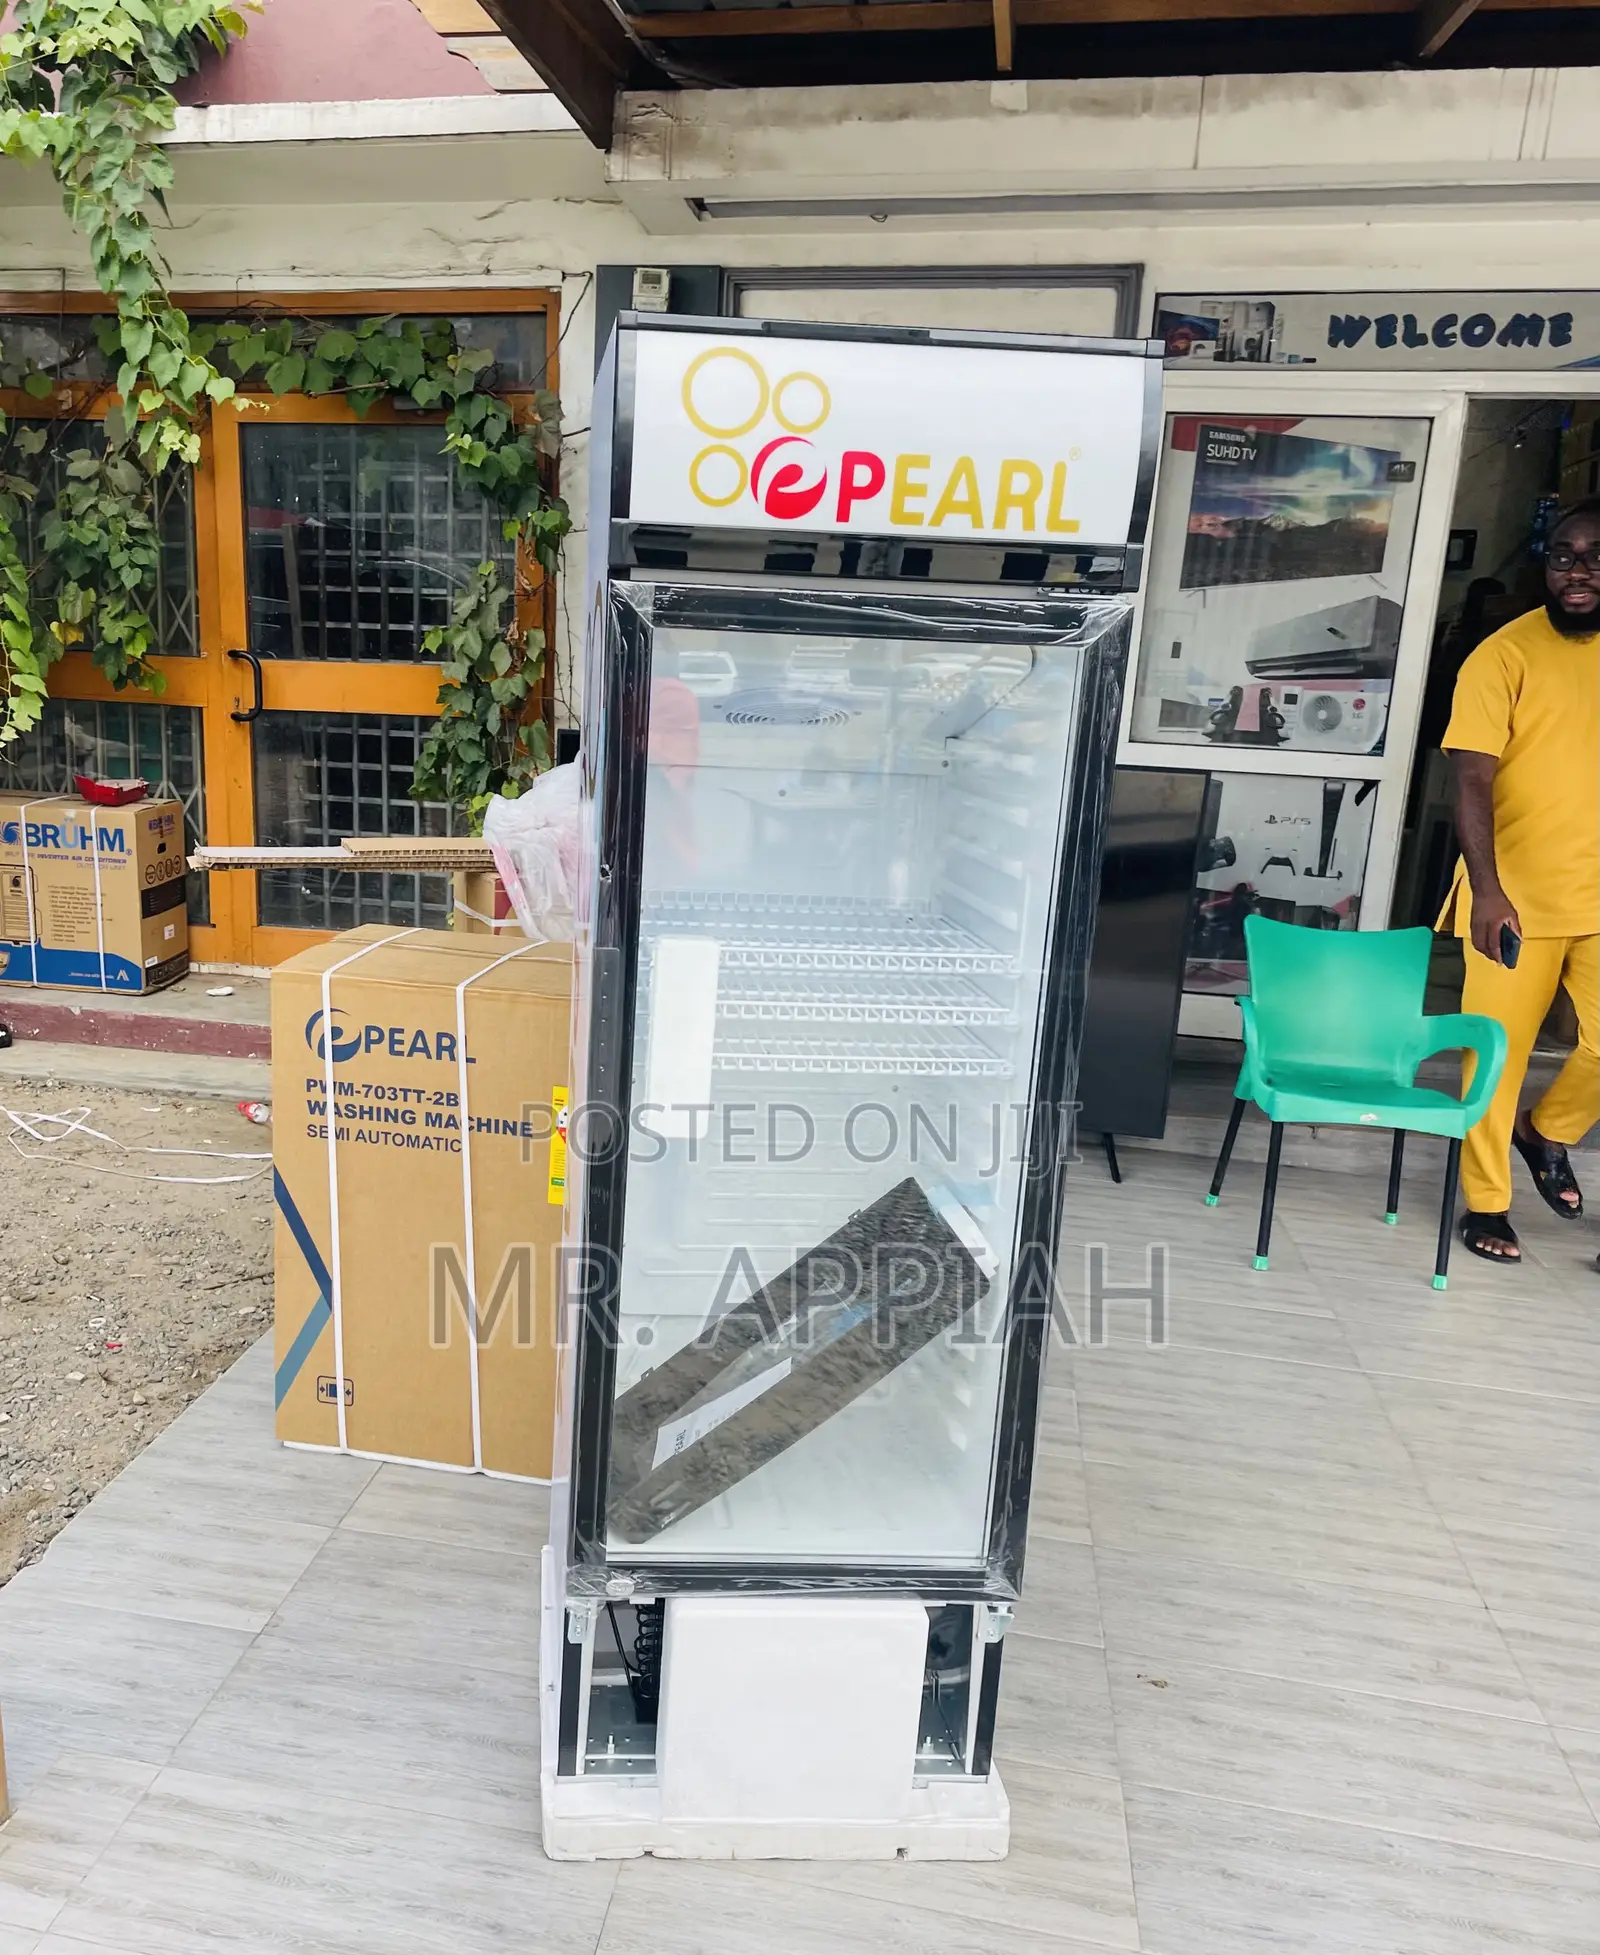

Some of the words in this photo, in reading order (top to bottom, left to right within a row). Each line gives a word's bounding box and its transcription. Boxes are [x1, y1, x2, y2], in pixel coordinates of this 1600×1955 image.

[1327, 312, 1574, 348] WELCOME
[1209, 431, 1246, 443] SAMSUNG
[1391, 464, 1411, 474] 4K
[835, 450, 1081, 533] PEARL
[1280, 817, 1311, 825] PS5
[364, 1025, 477, 1064] PEARL
[306, 1078, 459, 1107] PWM-703TT-2B
[307, 1100, 416, 1125] WASHING
[307, 1124, 350, 1141] SEMI
[355, 1129, 462, 1153] AUTOMATIC
